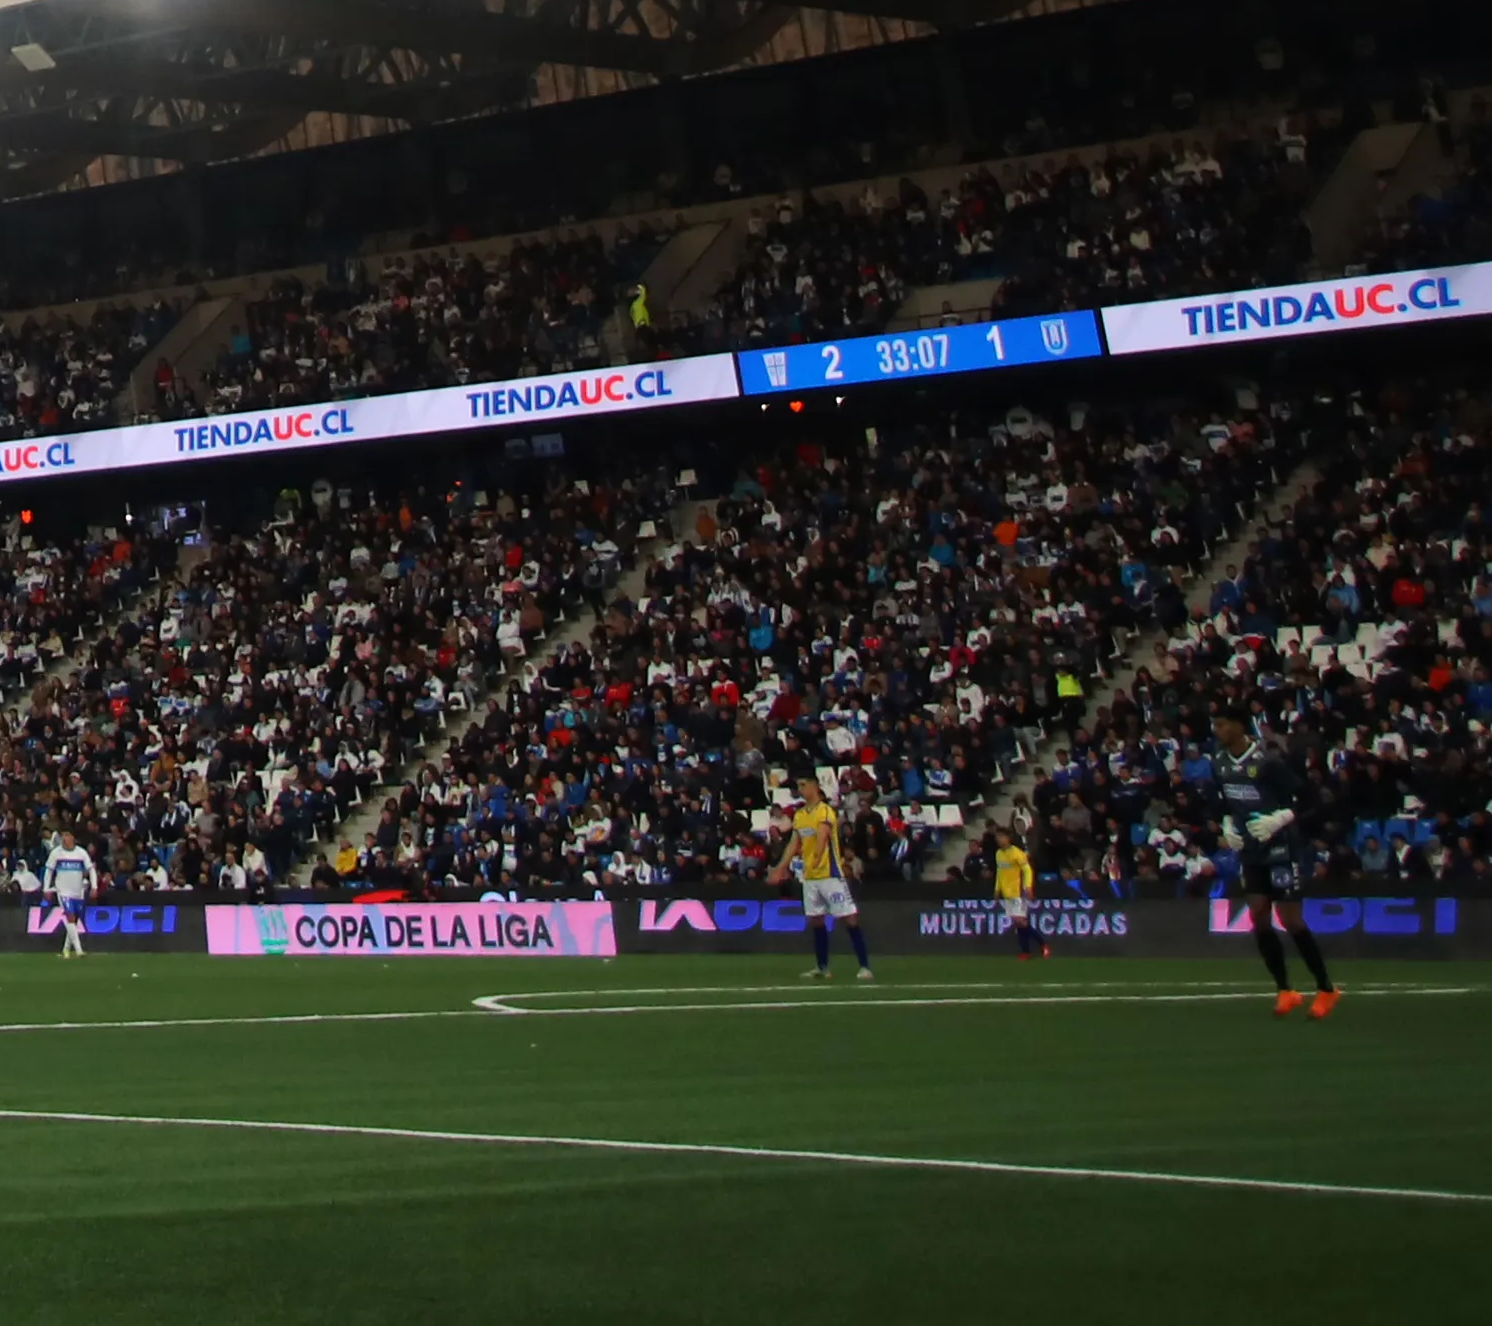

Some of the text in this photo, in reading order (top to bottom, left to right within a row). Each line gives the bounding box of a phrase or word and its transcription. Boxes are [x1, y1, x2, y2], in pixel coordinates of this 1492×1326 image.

[1180, 277, 1460, 336] TIENDAUC.CL
[821, 346, 844, 380] 2
[875, 334, 951, 374] 33:07
[986, 324, 1005, 361] 1
[466, 369, 672, 419] TIENDAUC.CL
[174, 409, 354, 452] TIENDAUC.CL
[295, 914, 554, 948] COPA DE LA LIGA
[919, 913, 1128, 935] MULTIPICADAS
